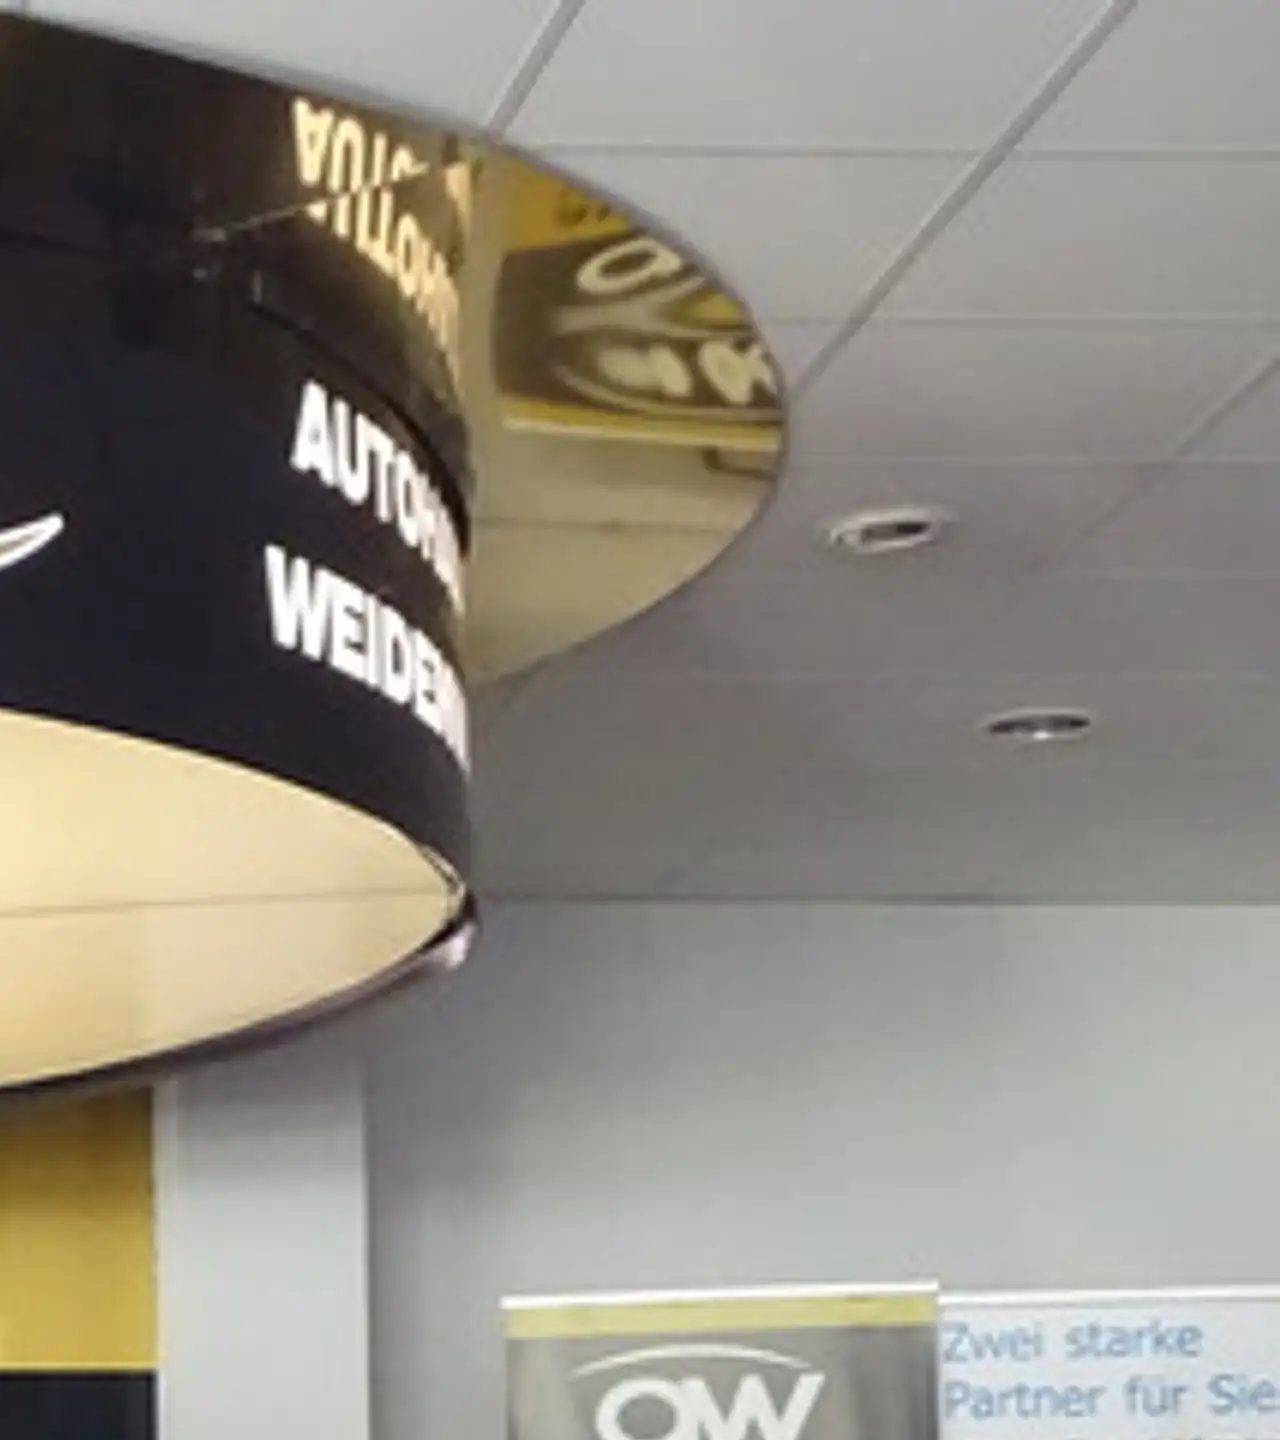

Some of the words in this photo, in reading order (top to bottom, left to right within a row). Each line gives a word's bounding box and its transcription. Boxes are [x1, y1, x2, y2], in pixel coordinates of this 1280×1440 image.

[944, 1322, 1043, 1361] Zwei
[1064, 1320, 1204, 1358] starke
[944, 1380, 1108, 1420] Partner
